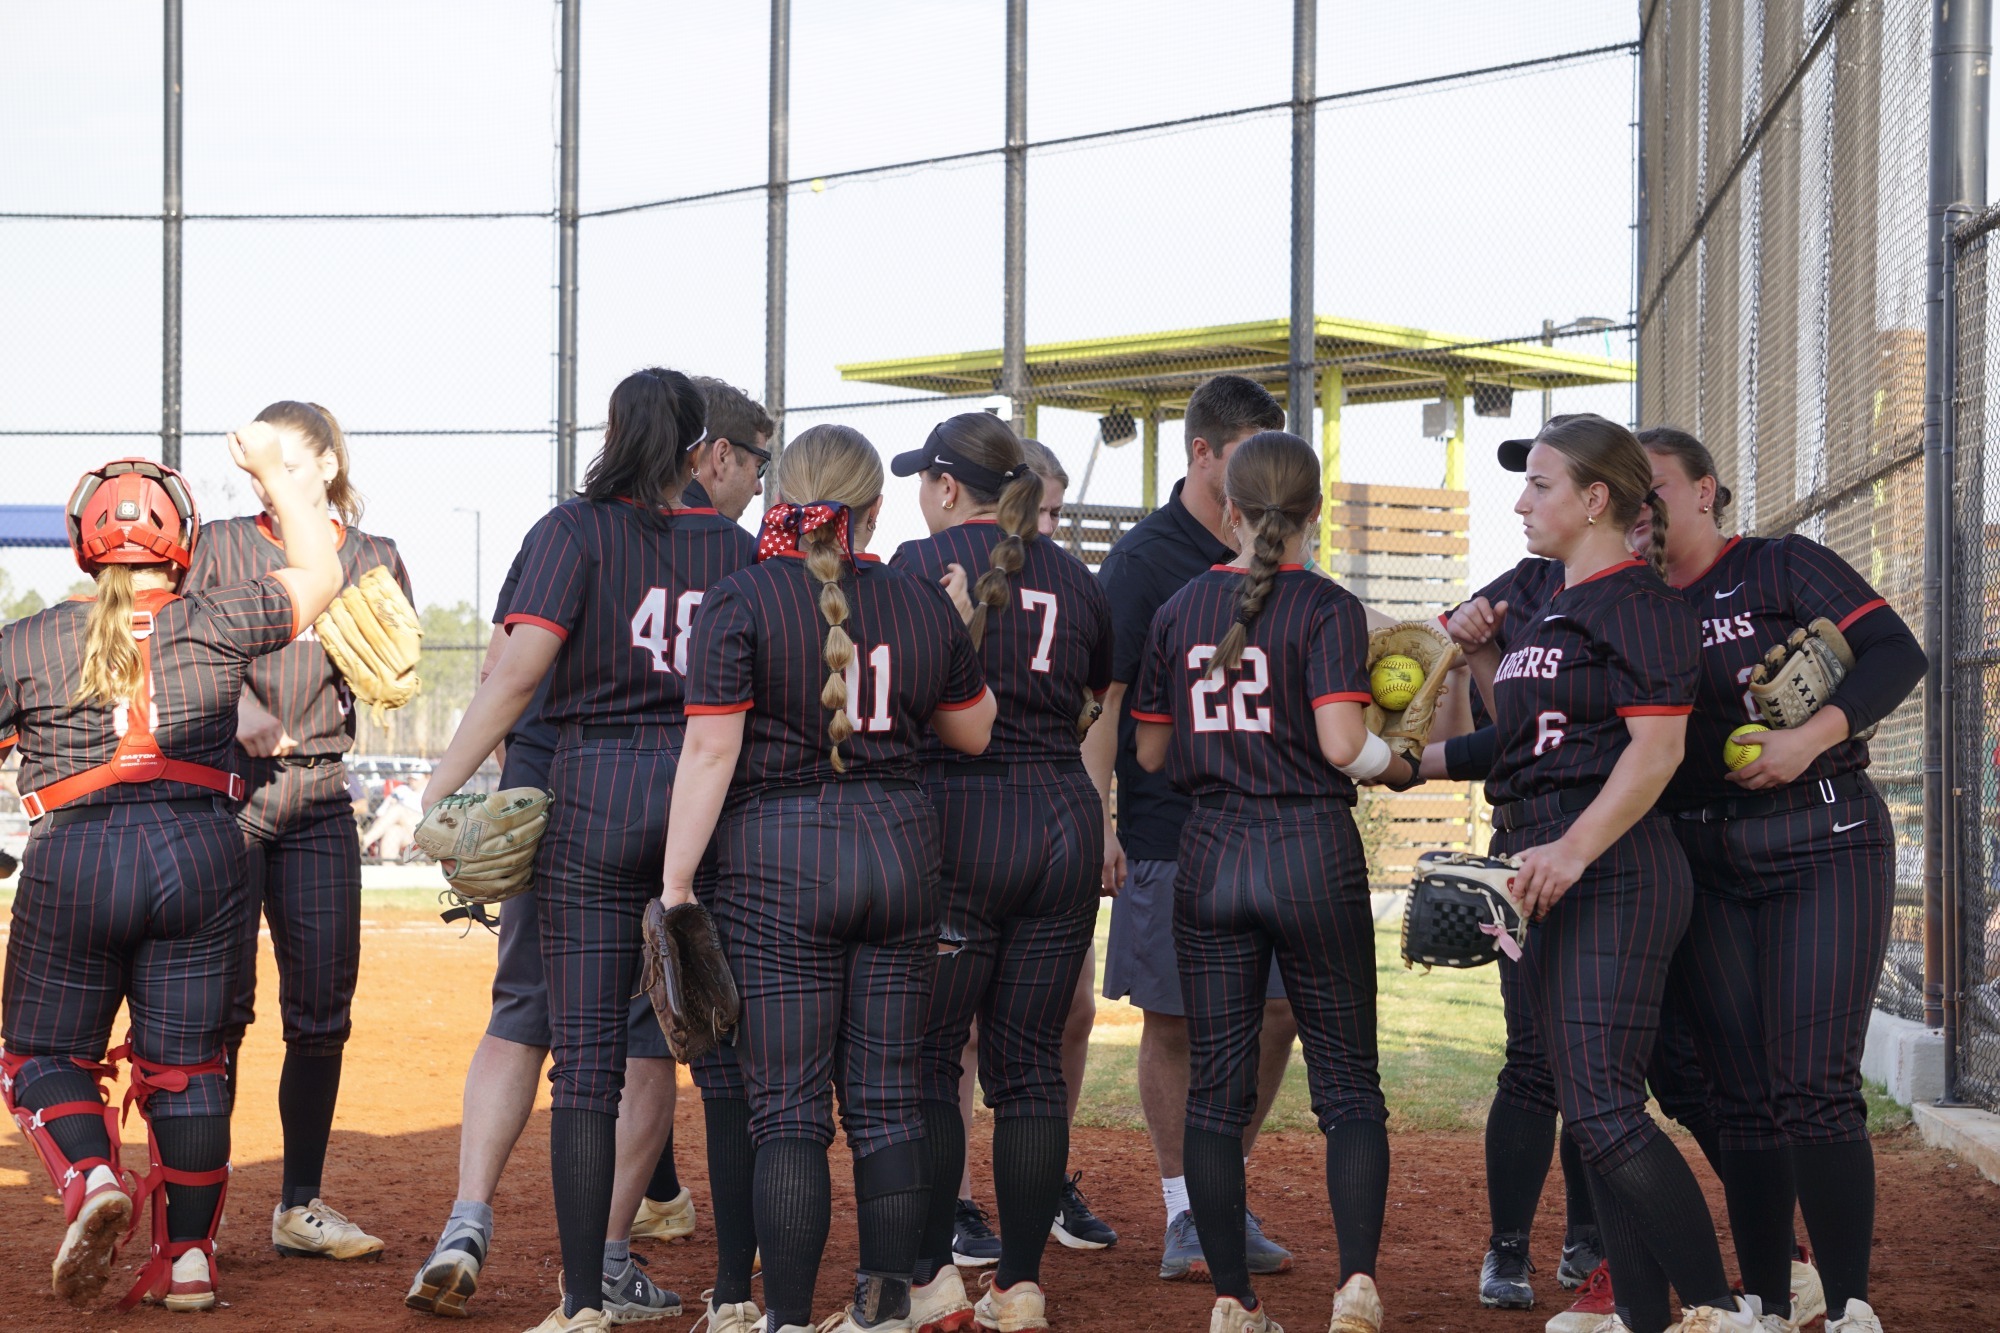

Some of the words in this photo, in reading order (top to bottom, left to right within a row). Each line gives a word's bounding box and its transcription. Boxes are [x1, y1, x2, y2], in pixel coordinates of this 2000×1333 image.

[1020, 588, 1058, 673] 7
[1702, 611, 1755, 648] ERS
[1187, 644, 1272, 734] 22
[1534, 710, 1568, 757] 6
